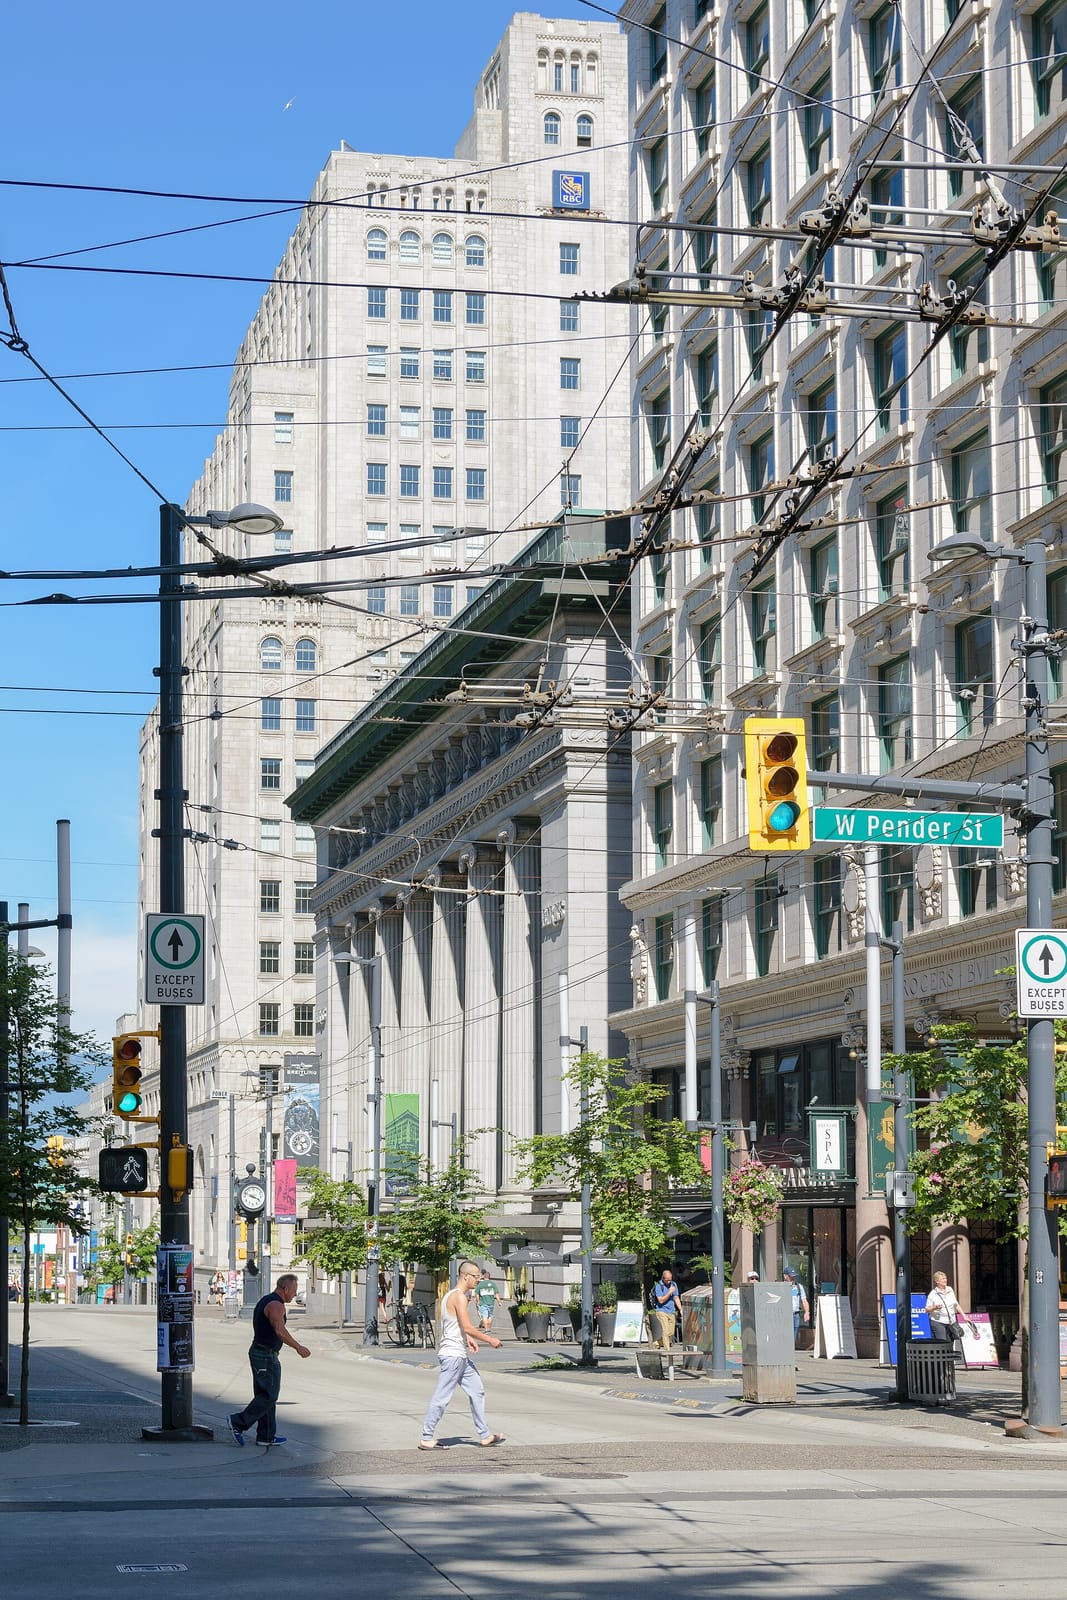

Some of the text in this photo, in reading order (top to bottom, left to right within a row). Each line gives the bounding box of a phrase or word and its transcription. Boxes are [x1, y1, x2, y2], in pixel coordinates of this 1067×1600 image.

[835, 814, 984, 841] W Pender St
[155, 974, 195, 986] EXCEPT
[157, 987, 193, 998] BUSES
[1027, 988, 1067, 998] EXCEPT
[1030, 1000, 1065, 1010] BUSES
[824, 1128, 833, 1165] SPA
